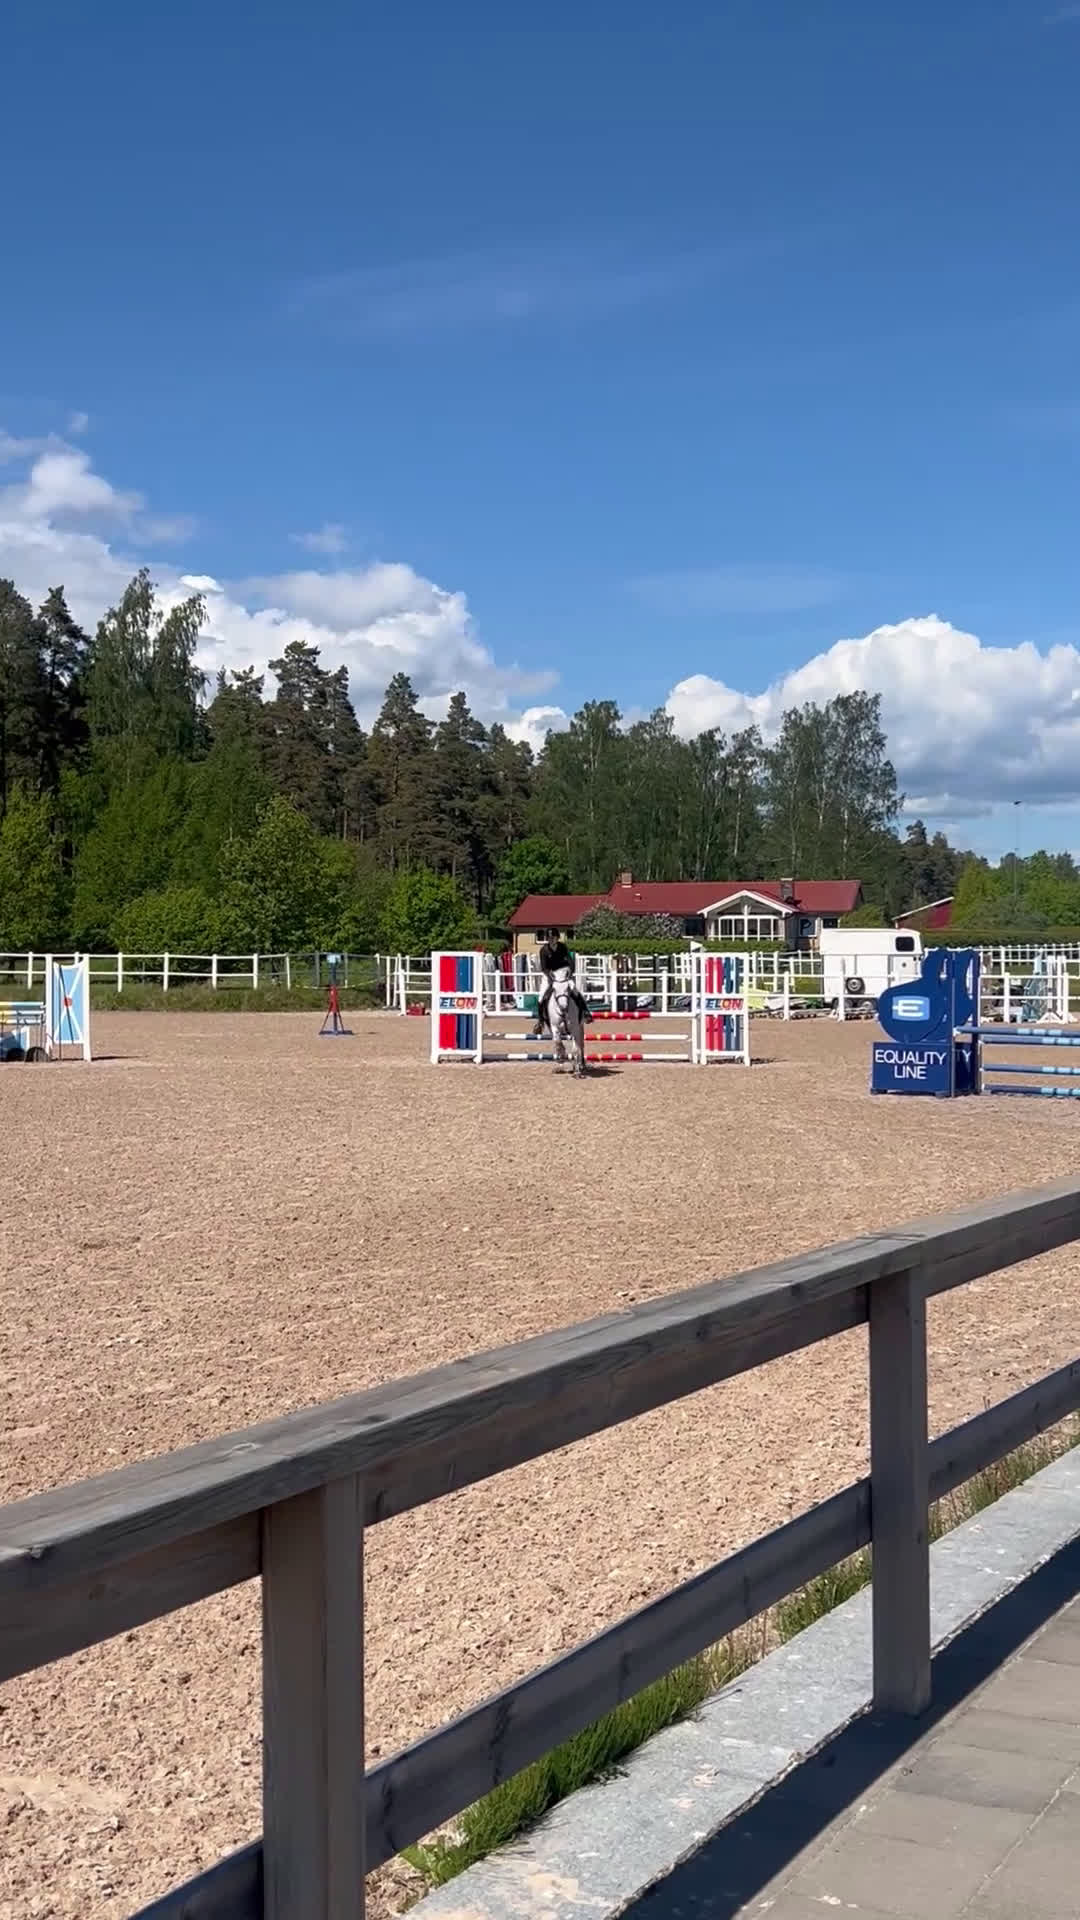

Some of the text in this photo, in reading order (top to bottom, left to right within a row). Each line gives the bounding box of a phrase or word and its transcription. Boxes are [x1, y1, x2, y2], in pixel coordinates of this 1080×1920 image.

[440, 997, 477, 1009] ELON
[705, 998, 744, 1010] ELON
[875, 1049, 946, 1065] EQUALITY
[894, 1066, 927, 1080] LINE
